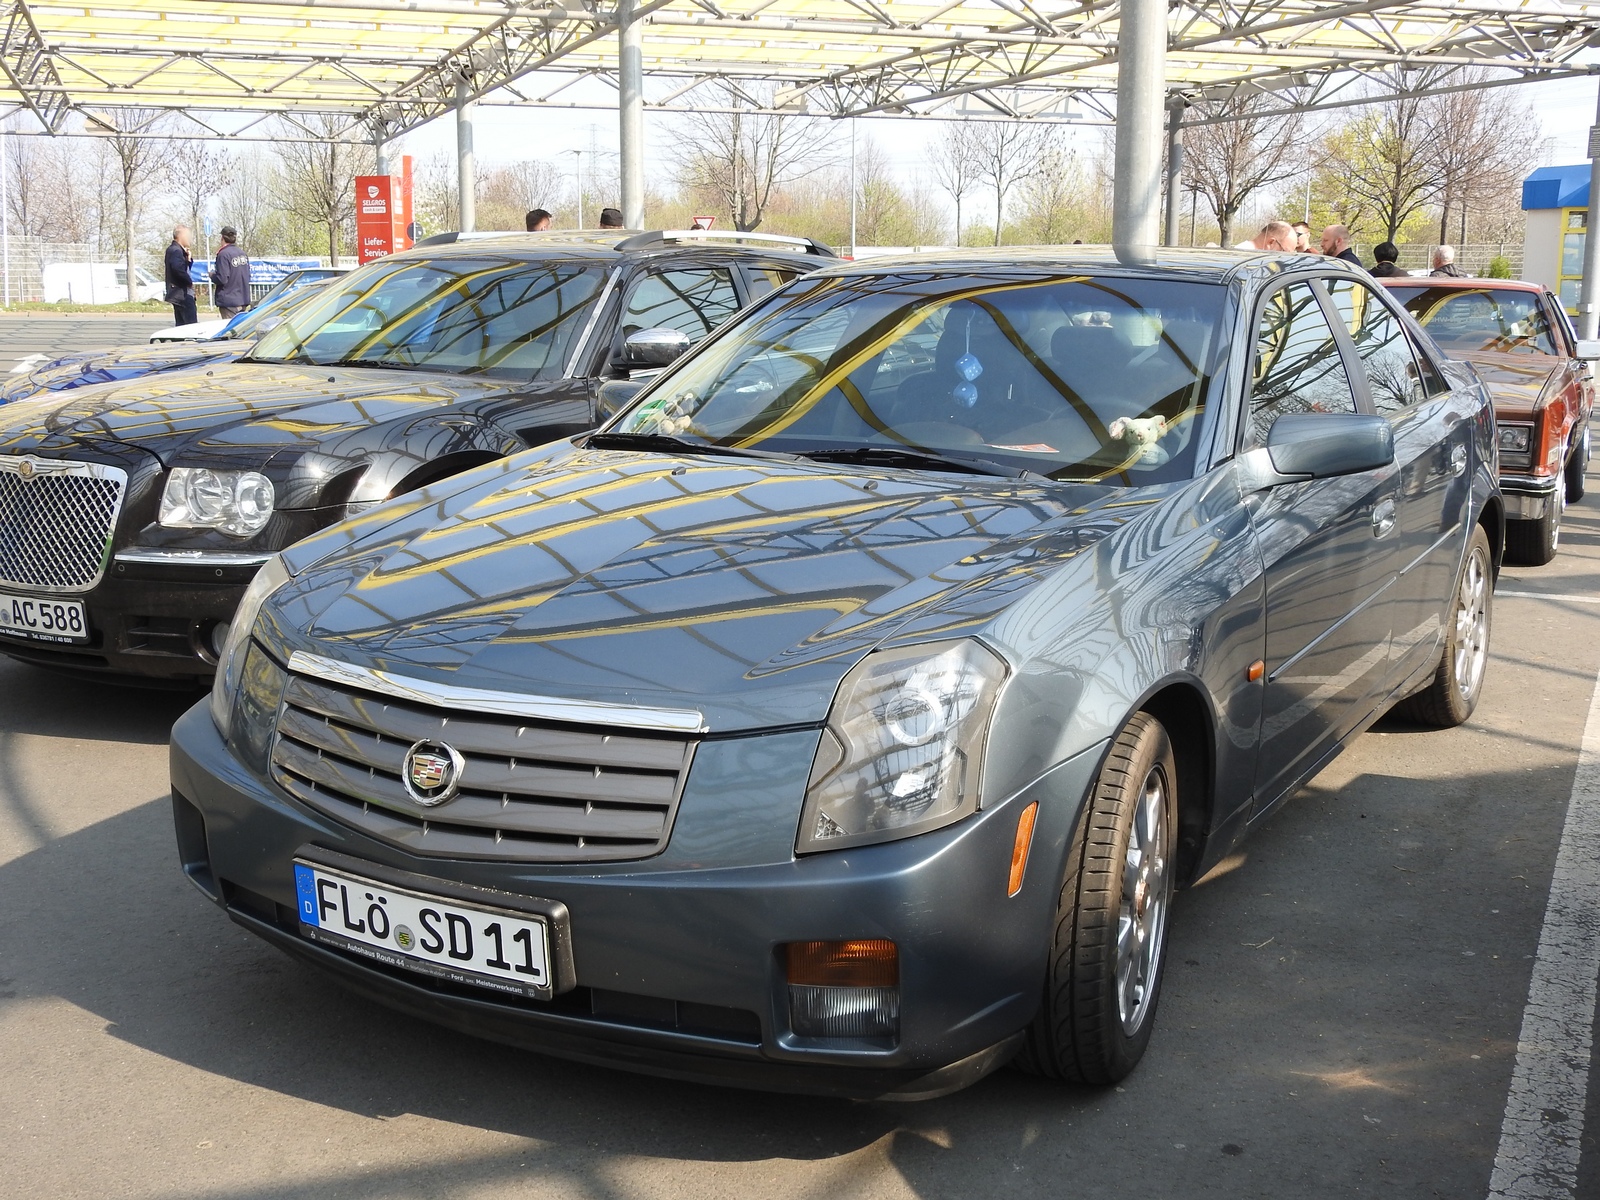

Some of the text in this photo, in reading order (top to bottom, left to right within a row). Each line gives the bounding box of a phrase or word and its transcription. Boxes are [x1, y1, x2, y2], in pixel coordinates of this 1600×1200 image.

[364, 238, 386, 246] Liefer-
[364, 249, 388, 257] Service
[12, 599, 82, 632] AC 588
[304, 900, 313, 914] D
[317, 878, 540, 977] FLÖ SD 11
[347, 942, 376, 958] Autohaus
[376, 952, 395, 964] Route
[396, 959, 405, 967] 44
[451, 973, 464, 981] Ford
[475, 978, 523, 994] Meisterwerkstatt
